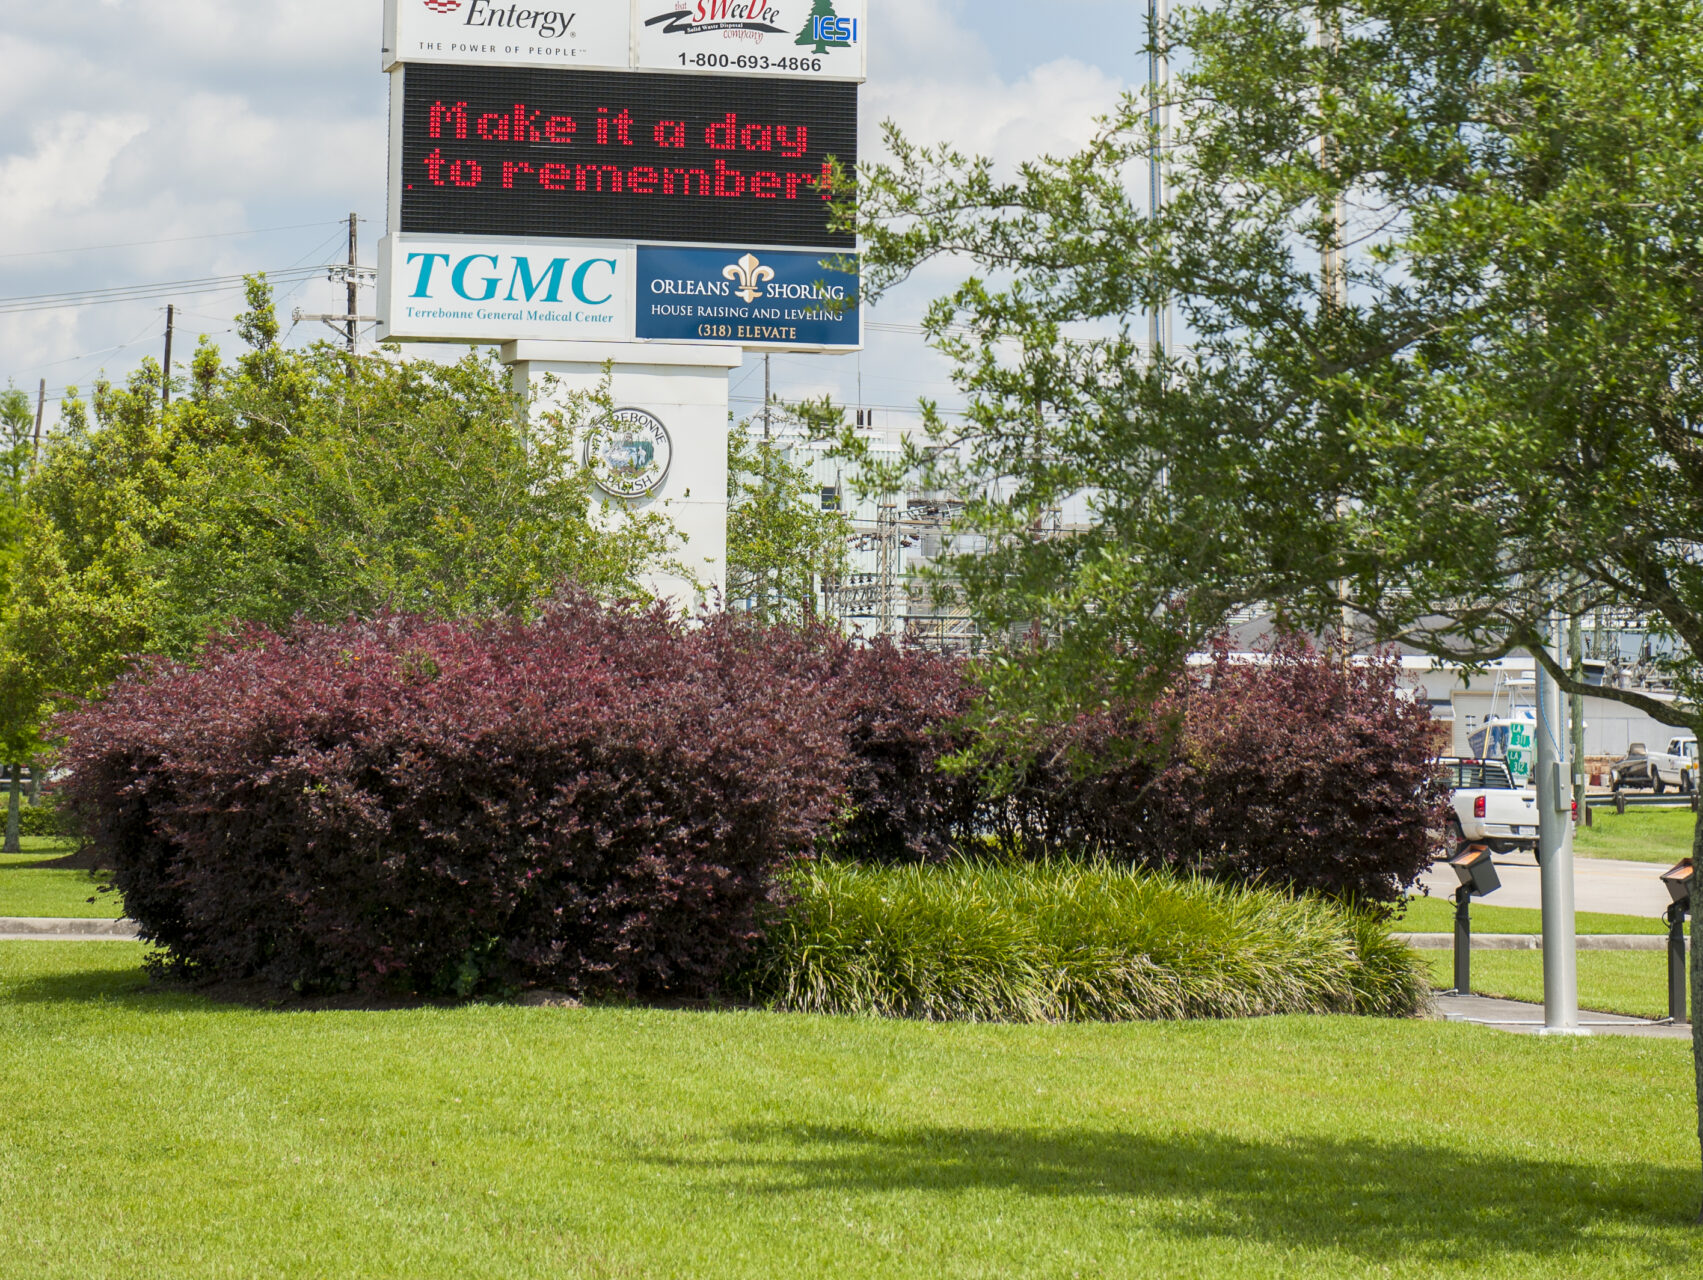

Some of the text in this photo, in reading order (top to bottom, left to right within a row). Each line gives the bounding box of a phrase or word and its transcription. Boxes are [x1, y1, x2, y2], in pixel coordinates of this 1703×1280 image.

[674, 1, 687, 11] that
[687, 22, 744, 34] Solid Waste Disposal
[723, 28, 764, 45] company
[813, 16, 858, 43] IESI
[419, 41, 577, 57] THE POWER OF PEOPLE
[678, 52, 822, 71] 1-800-693-4866
[429, 101, 808, 158] Make it a day
[423, 148, 832, 200] to remember!
[406, 252, 617, 305] TGMC
[650, 279, 845, 301] ORLEANS SHORING
[406, 306, 614, 323] Terrebonne General Medical Center
[651, 304, 843, 322] HOUSE RAISING AND LEVELING
[698, 324, 797, 339] (318) ELEVATE
[1512, 724, 1521, 733] LA
[1517, 735, 1527, 745] 311
[1510, 751, 1519, 760] LA
[1514, 761, 1525, 772] 312
